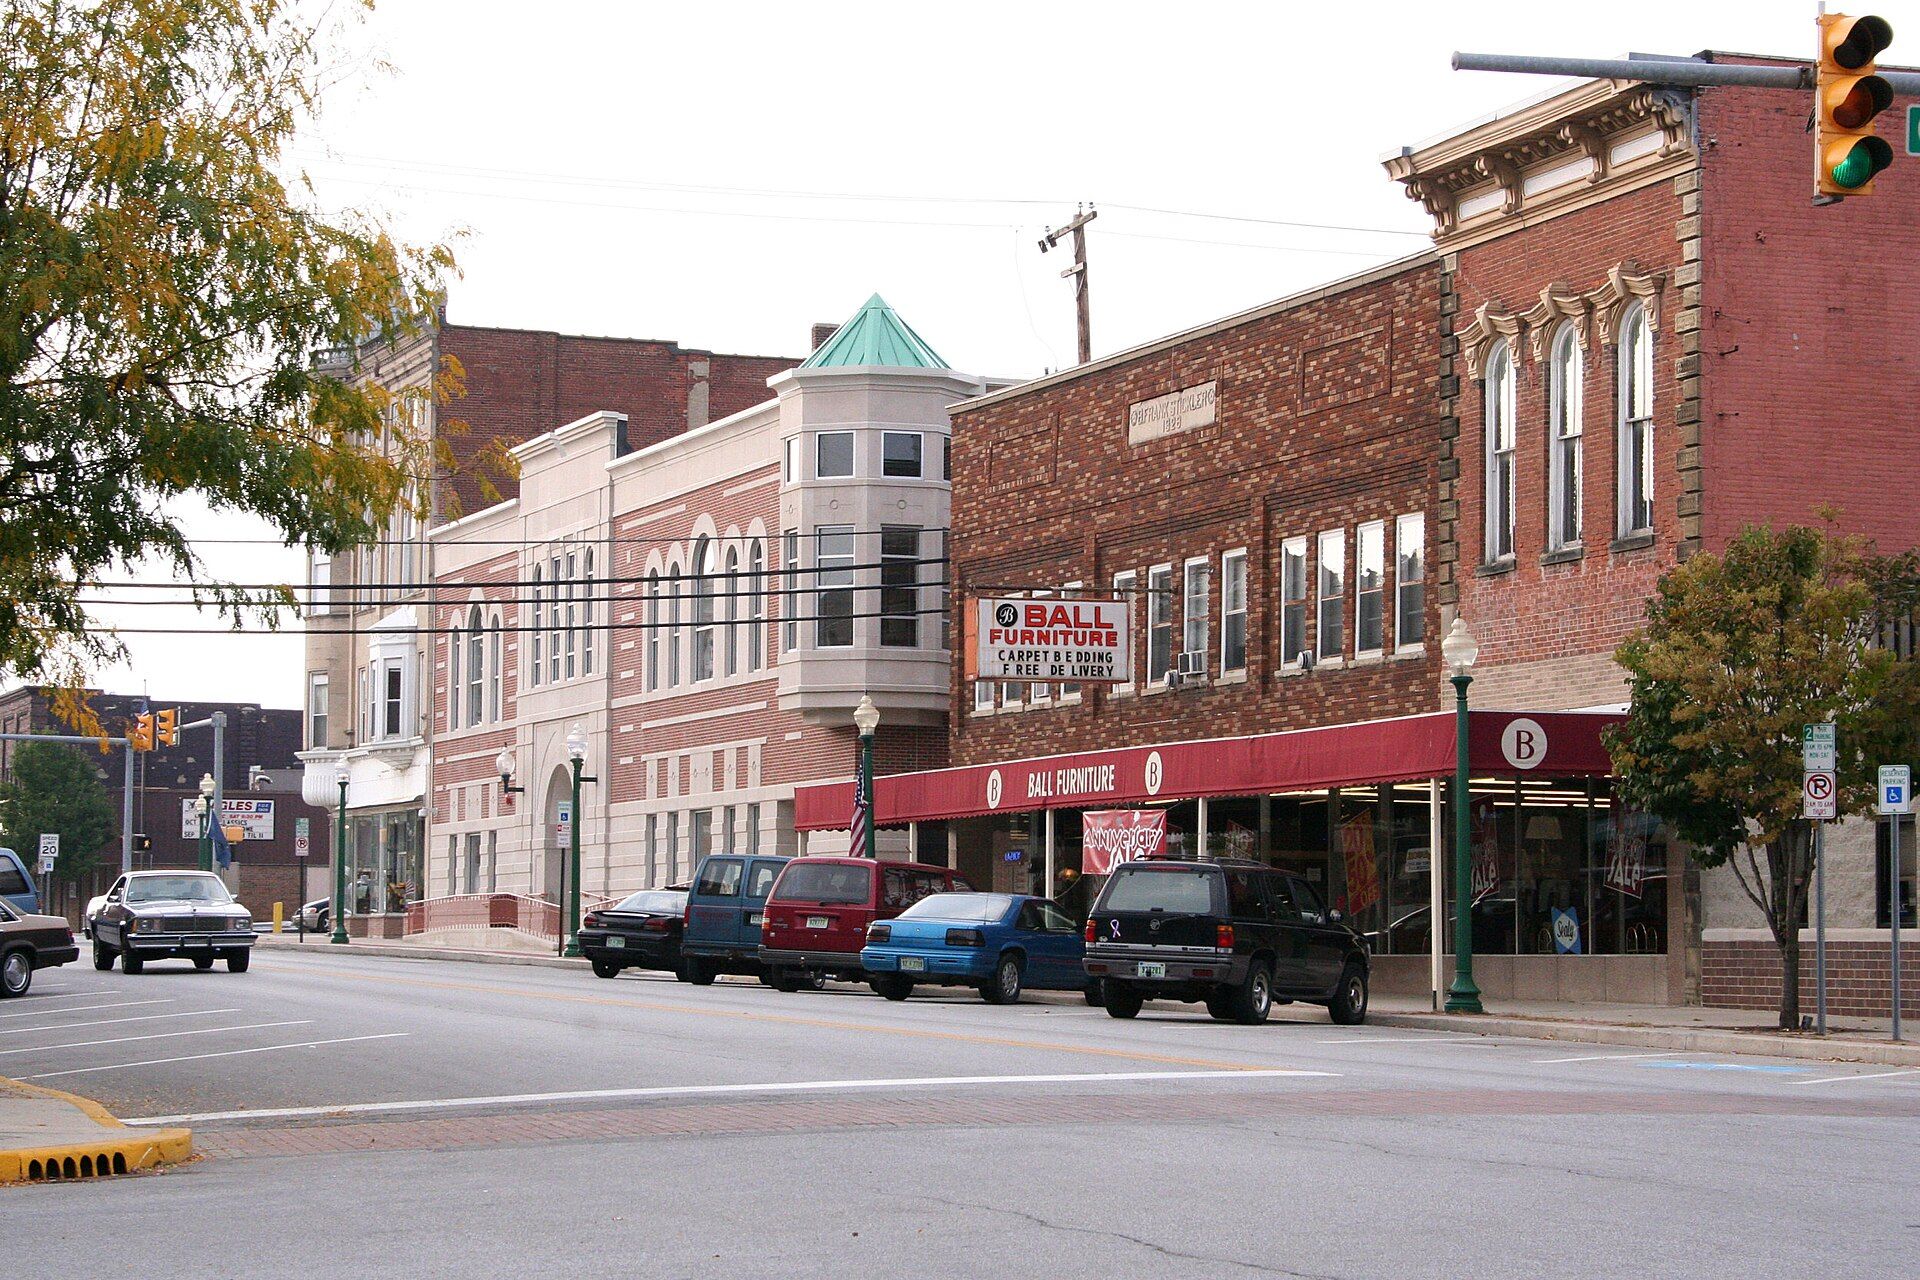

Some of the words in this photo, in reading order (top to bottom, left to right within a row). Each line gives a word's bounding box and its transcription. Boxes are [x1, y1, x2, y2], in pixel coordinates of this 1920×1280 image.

[1024, 605, 1114, 628] BALL
[989, 629, 1118, 647] FURNITURE
[998, 650, 1049, 662] CARPET
[1003, 664, 1039, 675] FREE
[1805, 727, 1812, 740] 2
[1515, 730, 1535, 759] B
[991, 779, 998, 801] B
[1027, 772, 1053, 798] BALL
[1056, 764, 1115, 796] FURNITURE
[1149, 762, 1157, 787] B
[42, 845, 57, 854] 20
